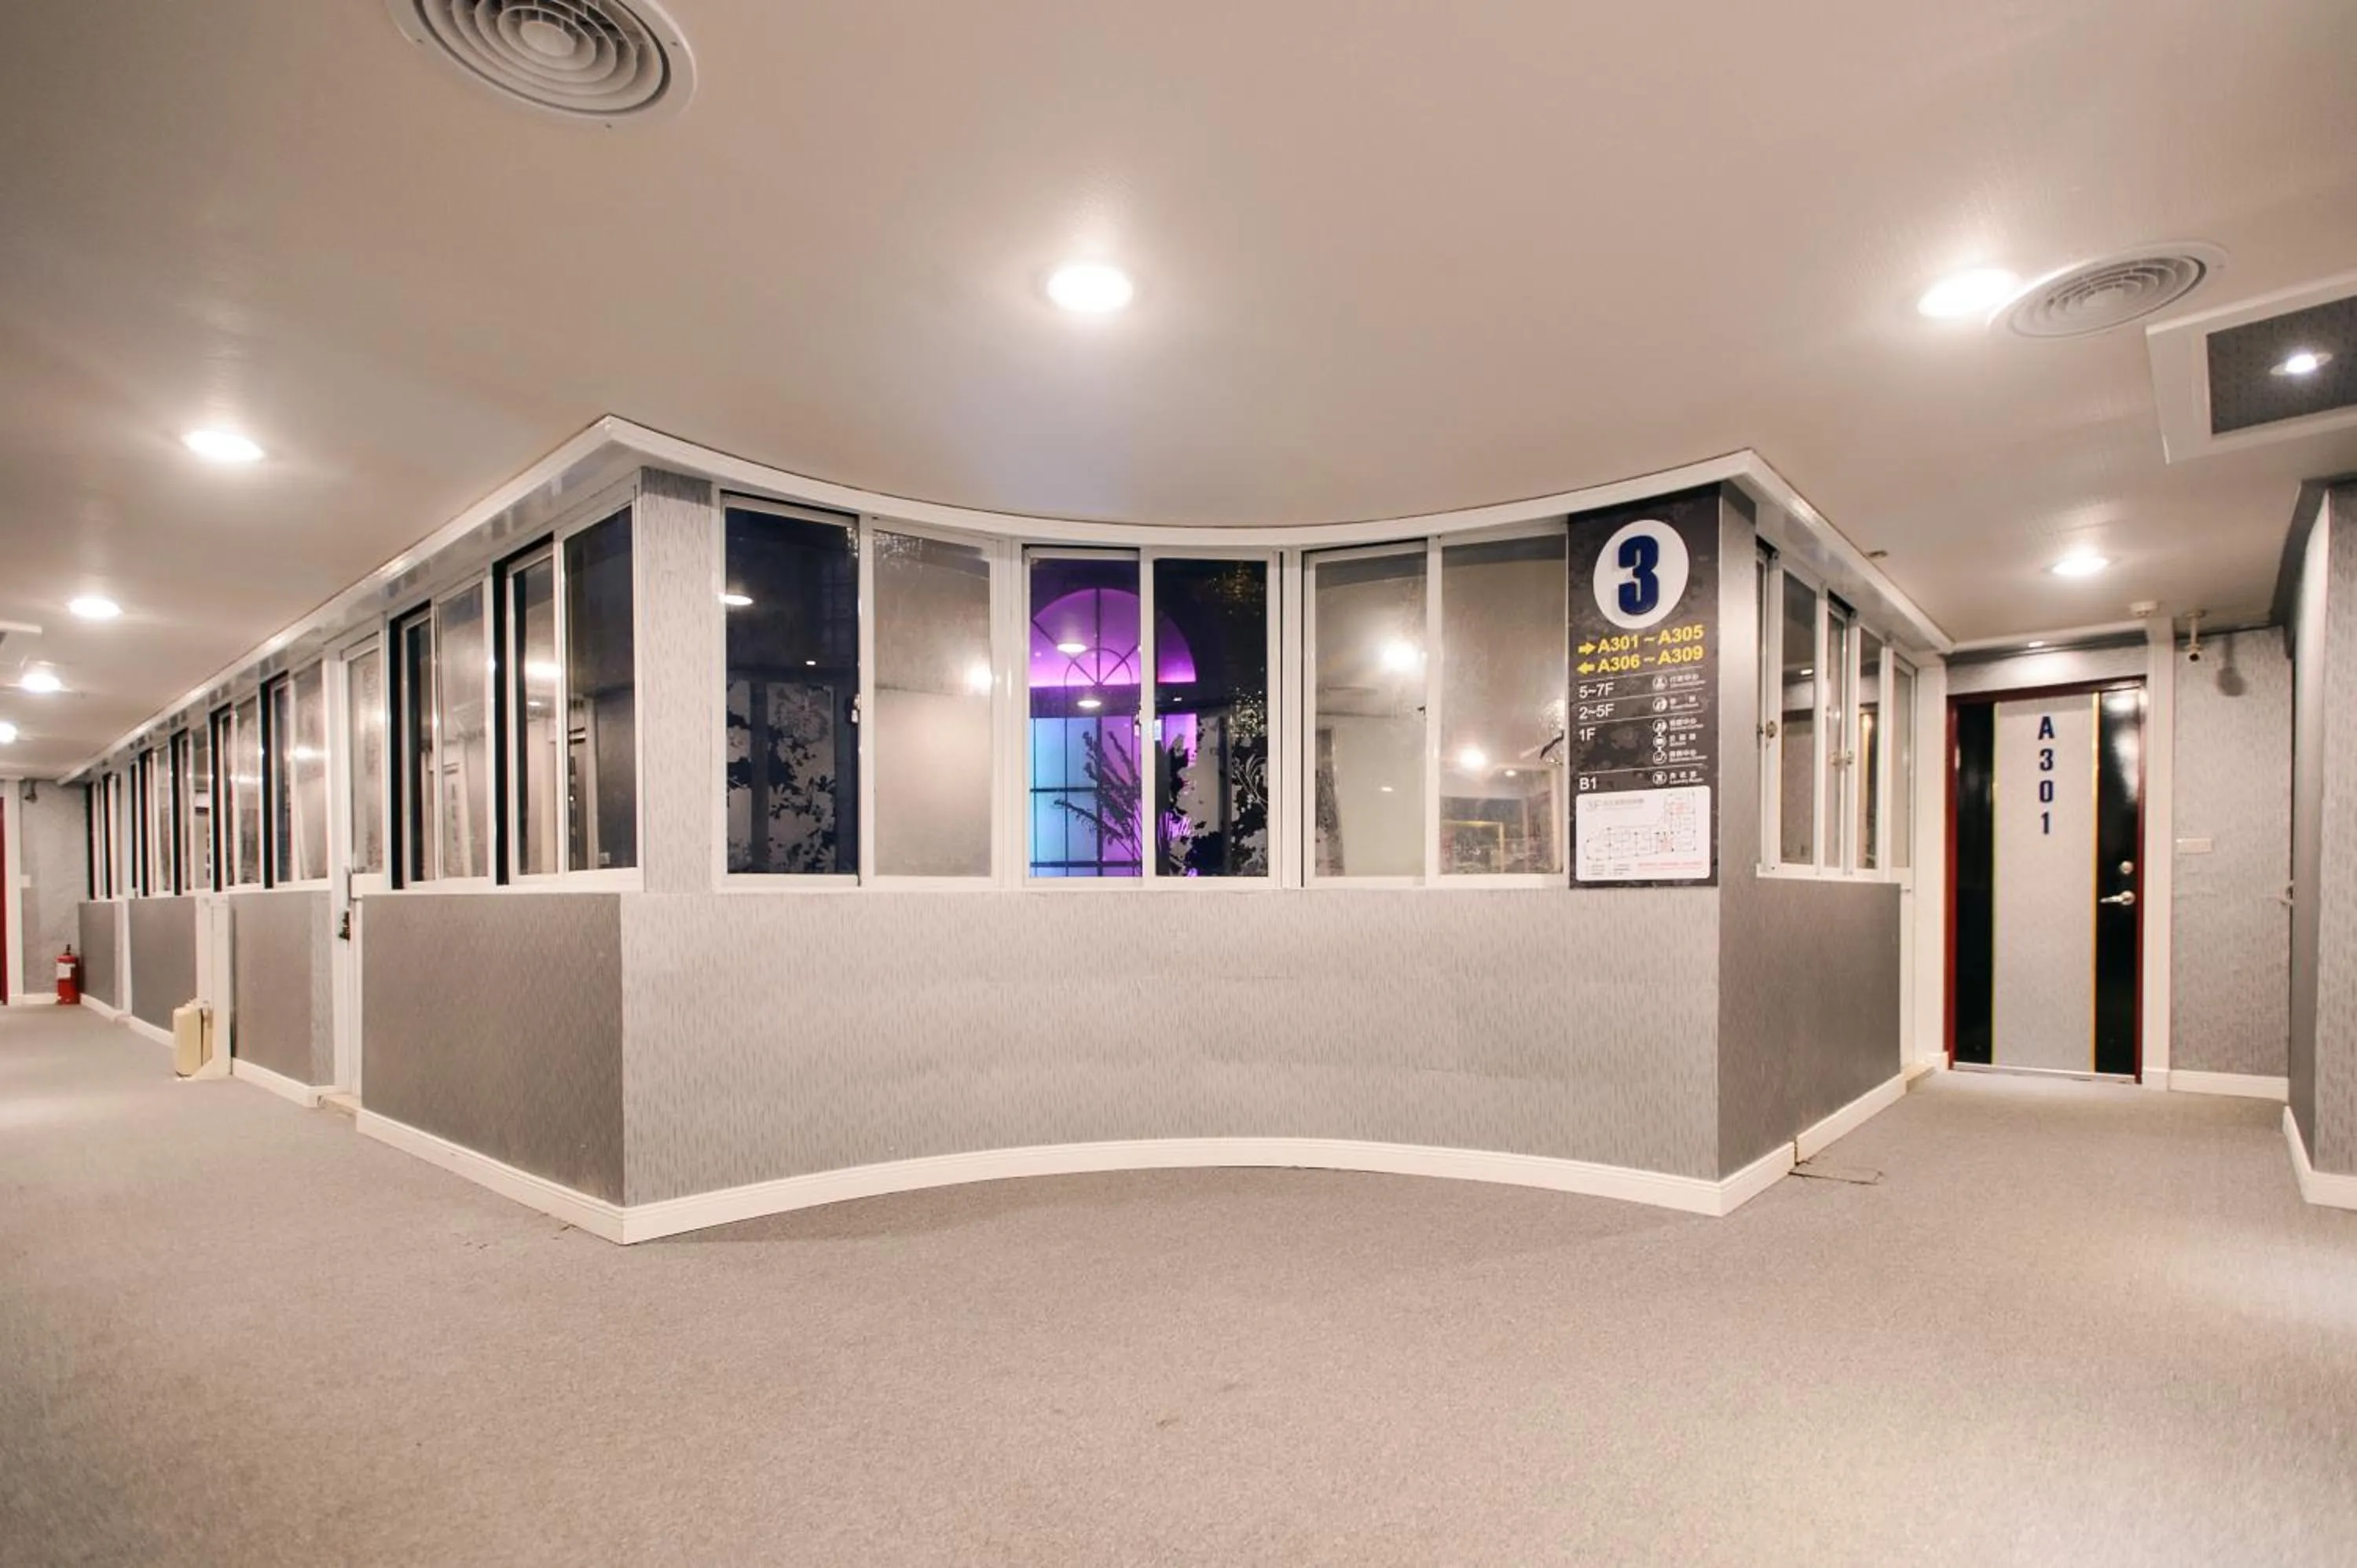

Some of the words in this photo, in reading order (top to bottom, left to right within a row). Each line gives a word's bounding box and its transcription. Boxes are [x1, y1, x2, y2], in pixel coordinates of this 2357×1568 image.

[1618, 535, 1659, 616] 3
[1597, 636, 1639, 654] A301
[1658, 625, 1704, 645] A305
[1597, 654, 1640, 673] A306
[1658, 646, 1704, 665] A309
[1579, 727, 1596, 741] 1F
[1579, 777, 1596, 789] B1
[2038, 716, 2055, 834] A301
